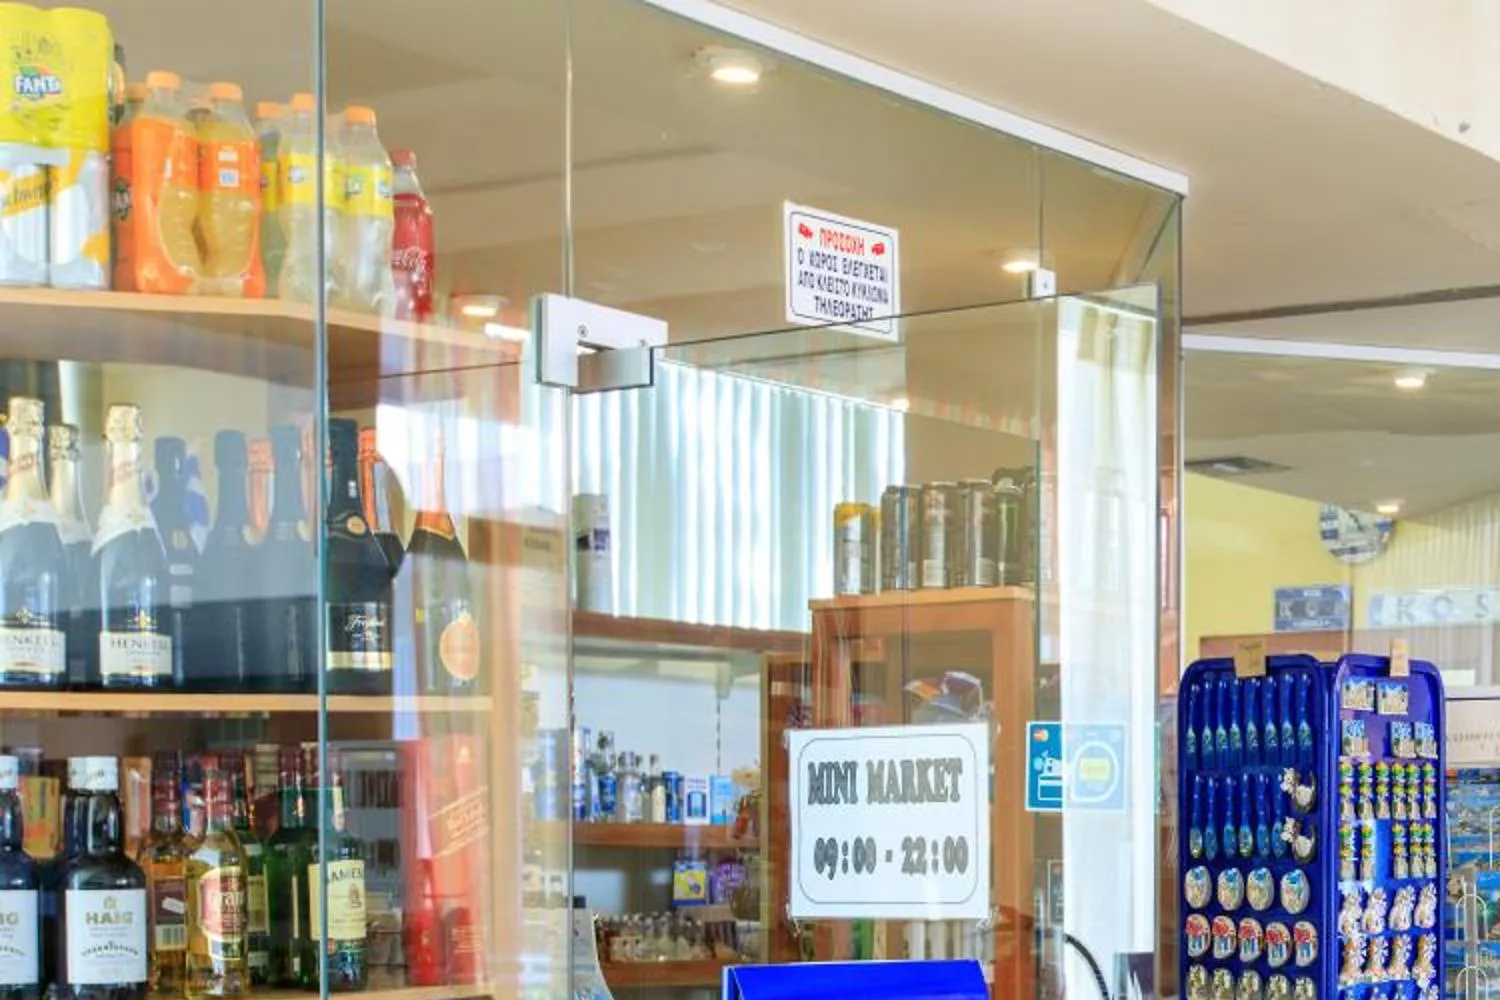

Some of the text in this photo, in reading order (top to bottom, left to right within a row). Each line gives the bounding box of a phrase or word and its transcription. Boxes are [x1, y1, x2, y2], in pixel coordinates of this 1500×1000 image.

[819, 227, 865, 256] ΠΡΟΣΟΧΗ
[809, 249, 838, 273] ΧΩΡΟΣ
[798, 269, 815, 289] ΑΠΟ
[807, 757, 963, 806] MINI MARKET
[813, 835, 877, 881] 09:00
[901, 834, 969, 876] 22:00
[85, 911, 134, 924] HAIG
